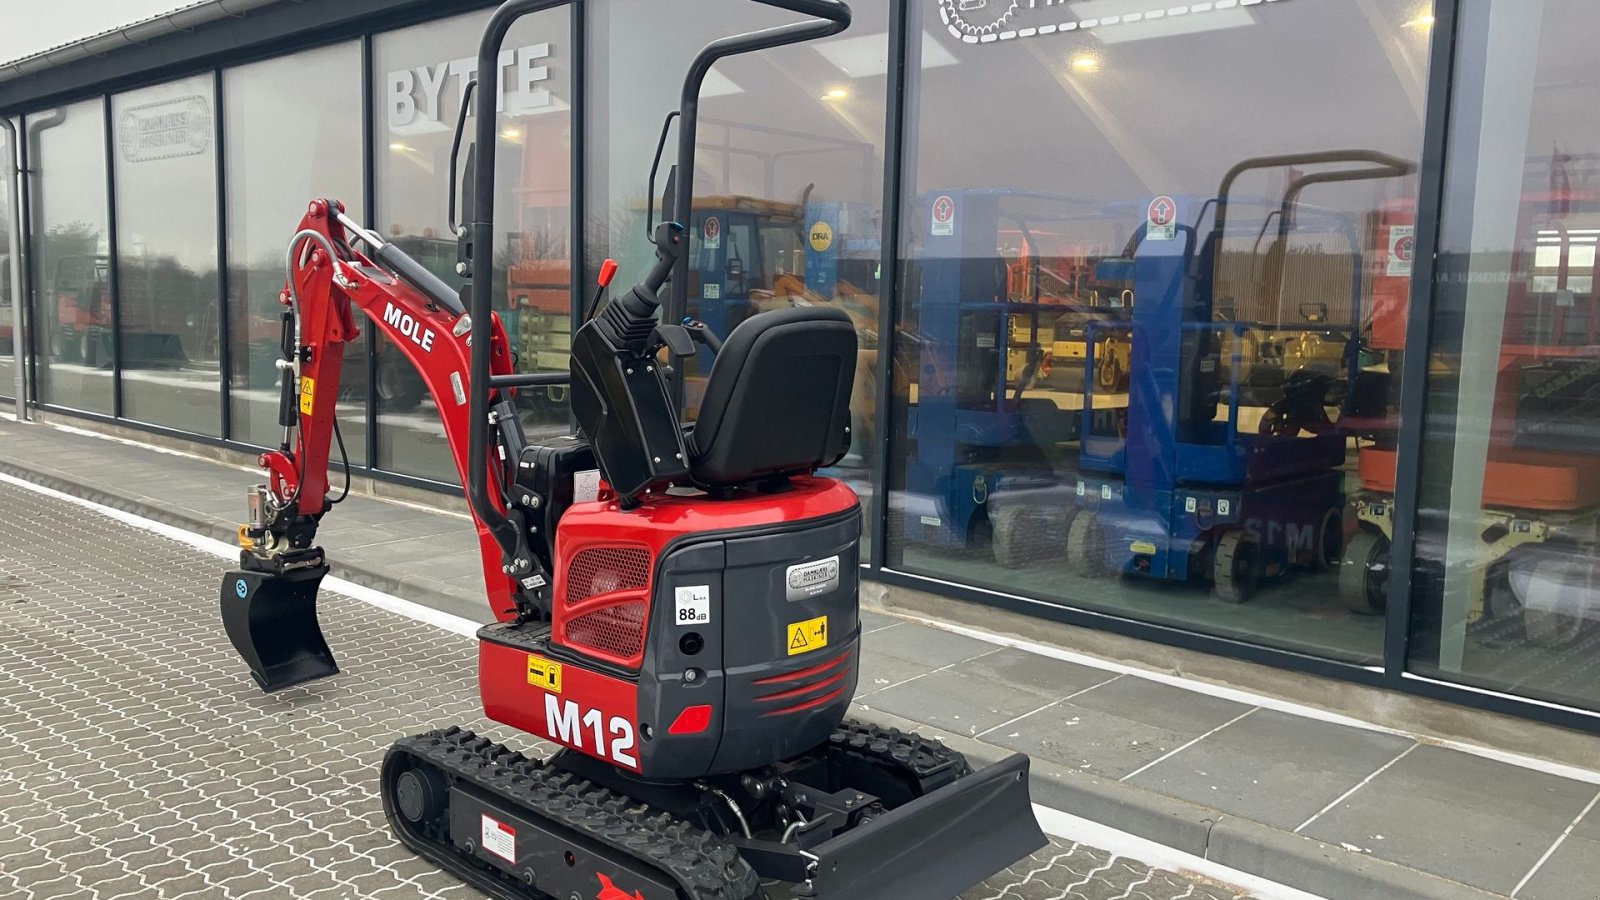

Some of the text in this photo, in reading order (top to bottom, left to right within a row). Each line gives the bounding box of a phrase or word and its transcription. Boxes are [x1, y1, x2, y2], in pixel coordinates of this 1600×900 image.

[387, 42, 549, 126] BYTTE
[383, 301, 435, 353] MOLE
[544, 692, 637, 769] M12
